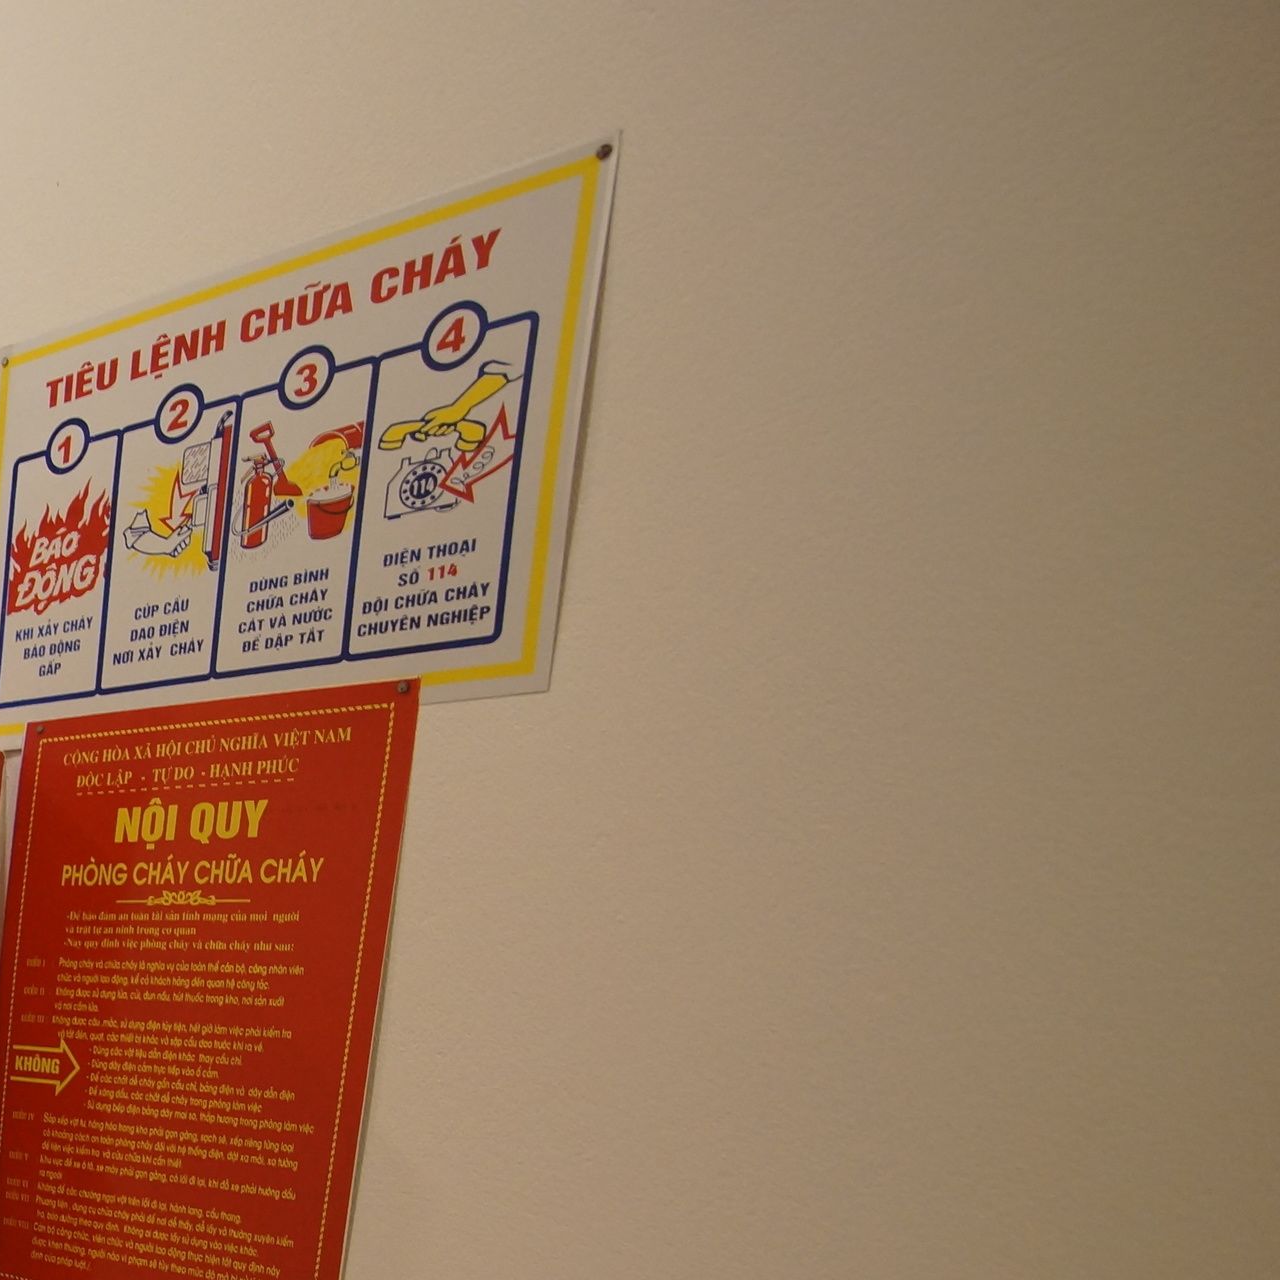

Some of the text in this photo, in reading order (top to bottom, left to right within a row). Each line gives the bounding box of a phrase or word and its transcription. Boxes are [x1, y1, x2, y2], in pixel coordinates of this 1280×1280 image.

[46, 228, 501, 409] TIÊU LỆNH CHỮA CHÁY
[436, 316, 466, 353] 4
[293, 363, 318, 398] 3
[166, 398, 190, 433] 2
[53, 435, 72, 469] 1
[29, 527, 81, 568] BÁO
[383, 538, 477, 568] ĐIỆN THOẠI
[15, 554, 97, 611] ĐỘNG
[249, 568, 330, 593] DÙNG BÌNH
[397, 563, 458, 587] SỐ 114
[246, 588, 328, 614] CHỮA CHÁY
[362, 581, 490, 616] ĐỘI CHỮA CHÁY
[130, 619, 190, 642] DAO ĐIỆN
[238, 608, 333, 634] CÁT VÀ NƯỚC
[357, 604, 491, 637] CHUYÊN NGHIỆP
[23, 638, 81, 660] BÁO ĐỘNG
[63, 726, 352, 766] CỘNG HÒA XÃ HỘI CHỦ NGHĨA VIỆT NAM
[76, 771, 104, 788] ĐỘC
[106, 768, 133, 788] LẬP
[152, 766, 173, 785] TỰ
[174, 766, 195, 781] DO
[209, 761, 253, 781] HẠNH
[256, 757, 300, 775] PHÚC
[113, 797, 269, 851] NỘI QUY
[60, 849, 325, 887] PHÒNG CHÁY CHỮA CHÁY
[14, 1054, 61, 1075] KHÔNG
